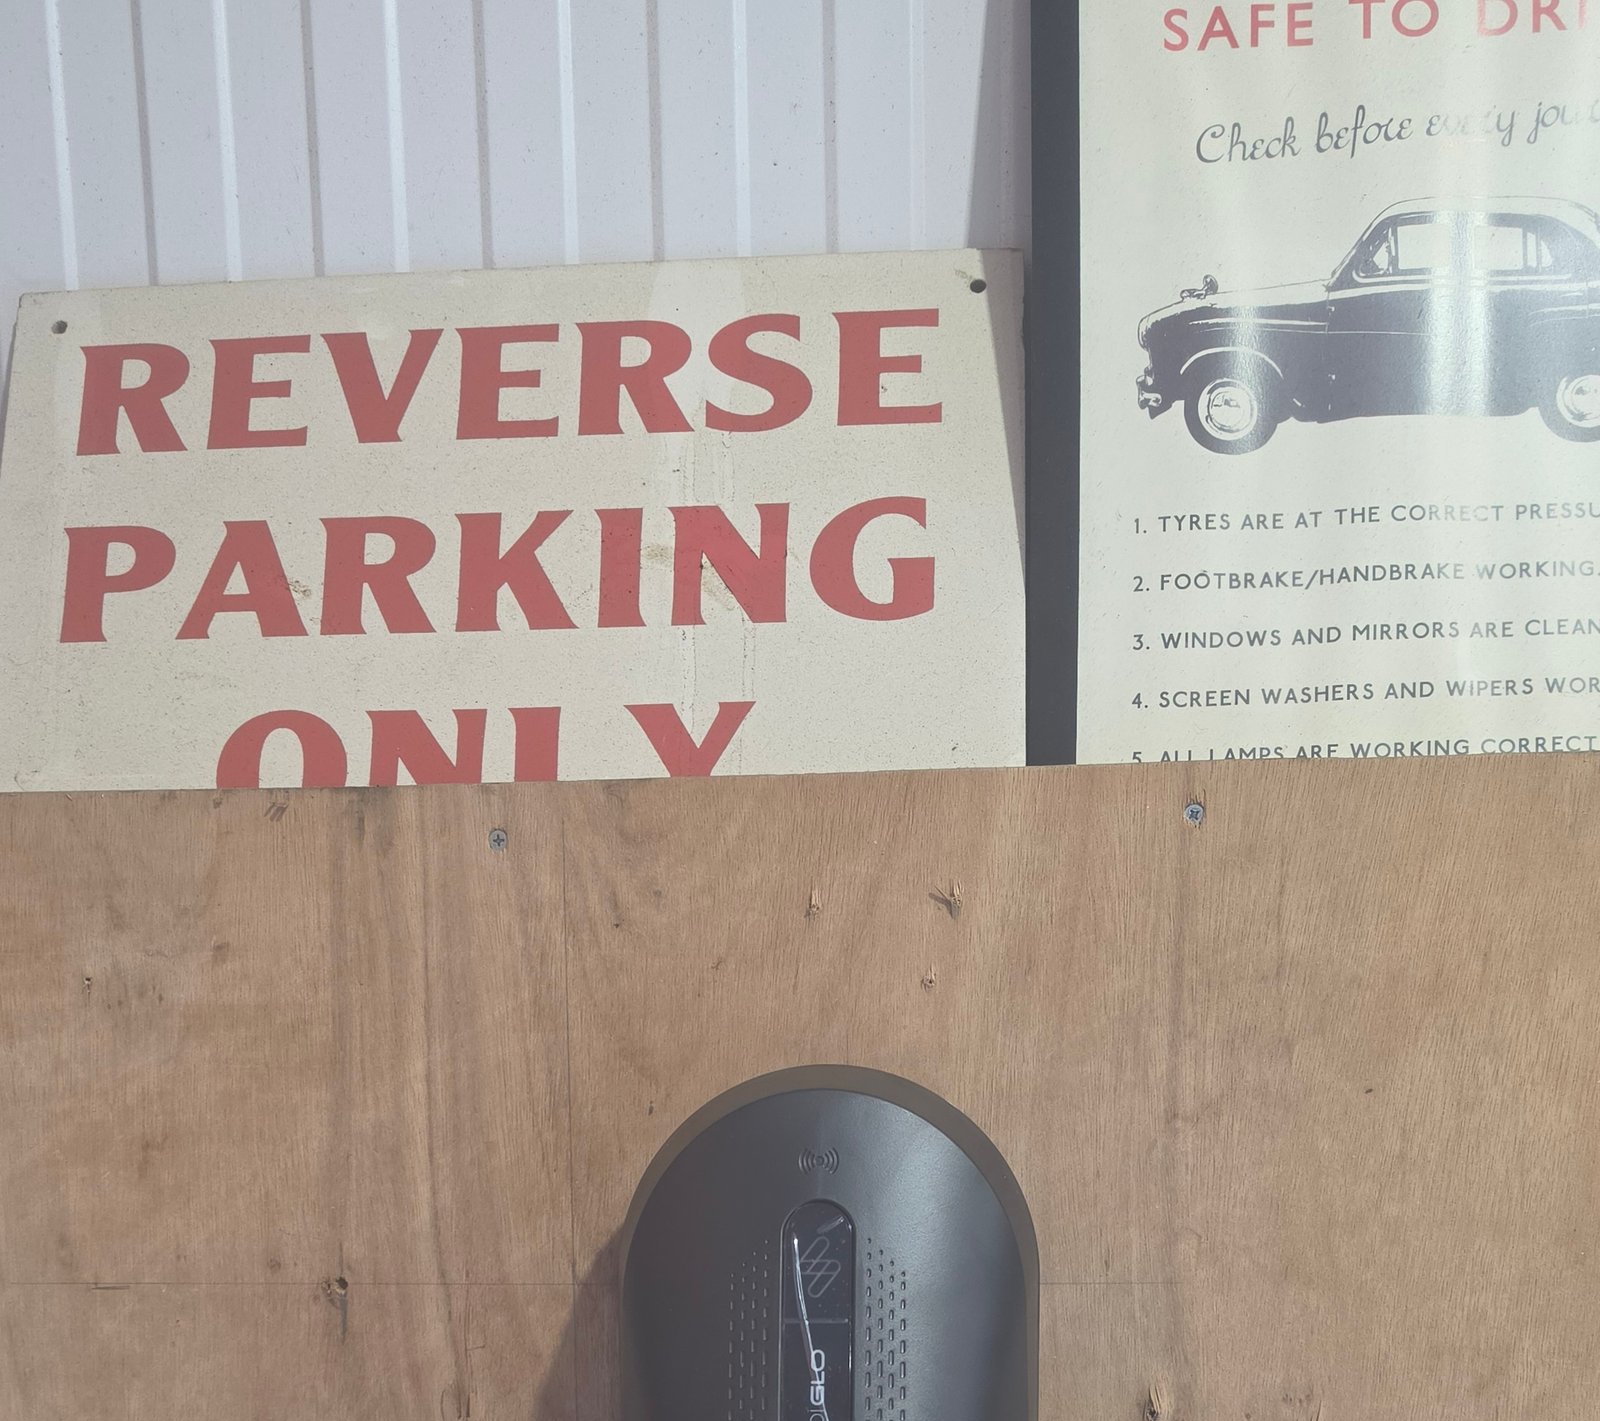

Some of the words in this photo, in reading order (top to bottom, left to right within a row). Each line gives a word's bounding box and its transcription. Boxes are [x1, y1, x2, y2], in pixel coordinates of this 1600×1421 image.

[1163, 3, 1313, 51] SAFE
[1349, 0, 1440, 39] TO
[1196, 116, 1301, 163] Check
[1315, 104, 1413, 159] before
[76, 308, 942, 456] REVERSE
[1135, 518, 1147, 534] 1.
[1158, 514, 1230, 532] TYRES
[1241, 513, 1284, 530] ARE
[1295, 511, 1322, 528] AT
[1334, 506, 1380, 524] THE
[1391, 505, 1504, 521] CORRECT
[59, 496, 935, 643] PARKING
[1134, 576, 1149, 592] 2.
[1161, 563, 1463, 590] FOOTBRAKE/HANDBRAKE
[1133, 634, 1150, 650] 3.
[1161, 630, 1281, 649] WINDOWS
[1292, 627, 1341, 645] AND
[1353, 622, 1459, 641] MIRRORS
[1470, 621, 1514, 638] ARE
[1132, 693, 1148, 709] 4.
[1159, 689, 1249, 708] SCREEN
[1261, 683, 1373, 704] WASHERS
[1384, 682, 1434, 699] AND
[1446, 678, 1533, 696] WIPERS
[1350, 739, 1470, 759] WORKING
